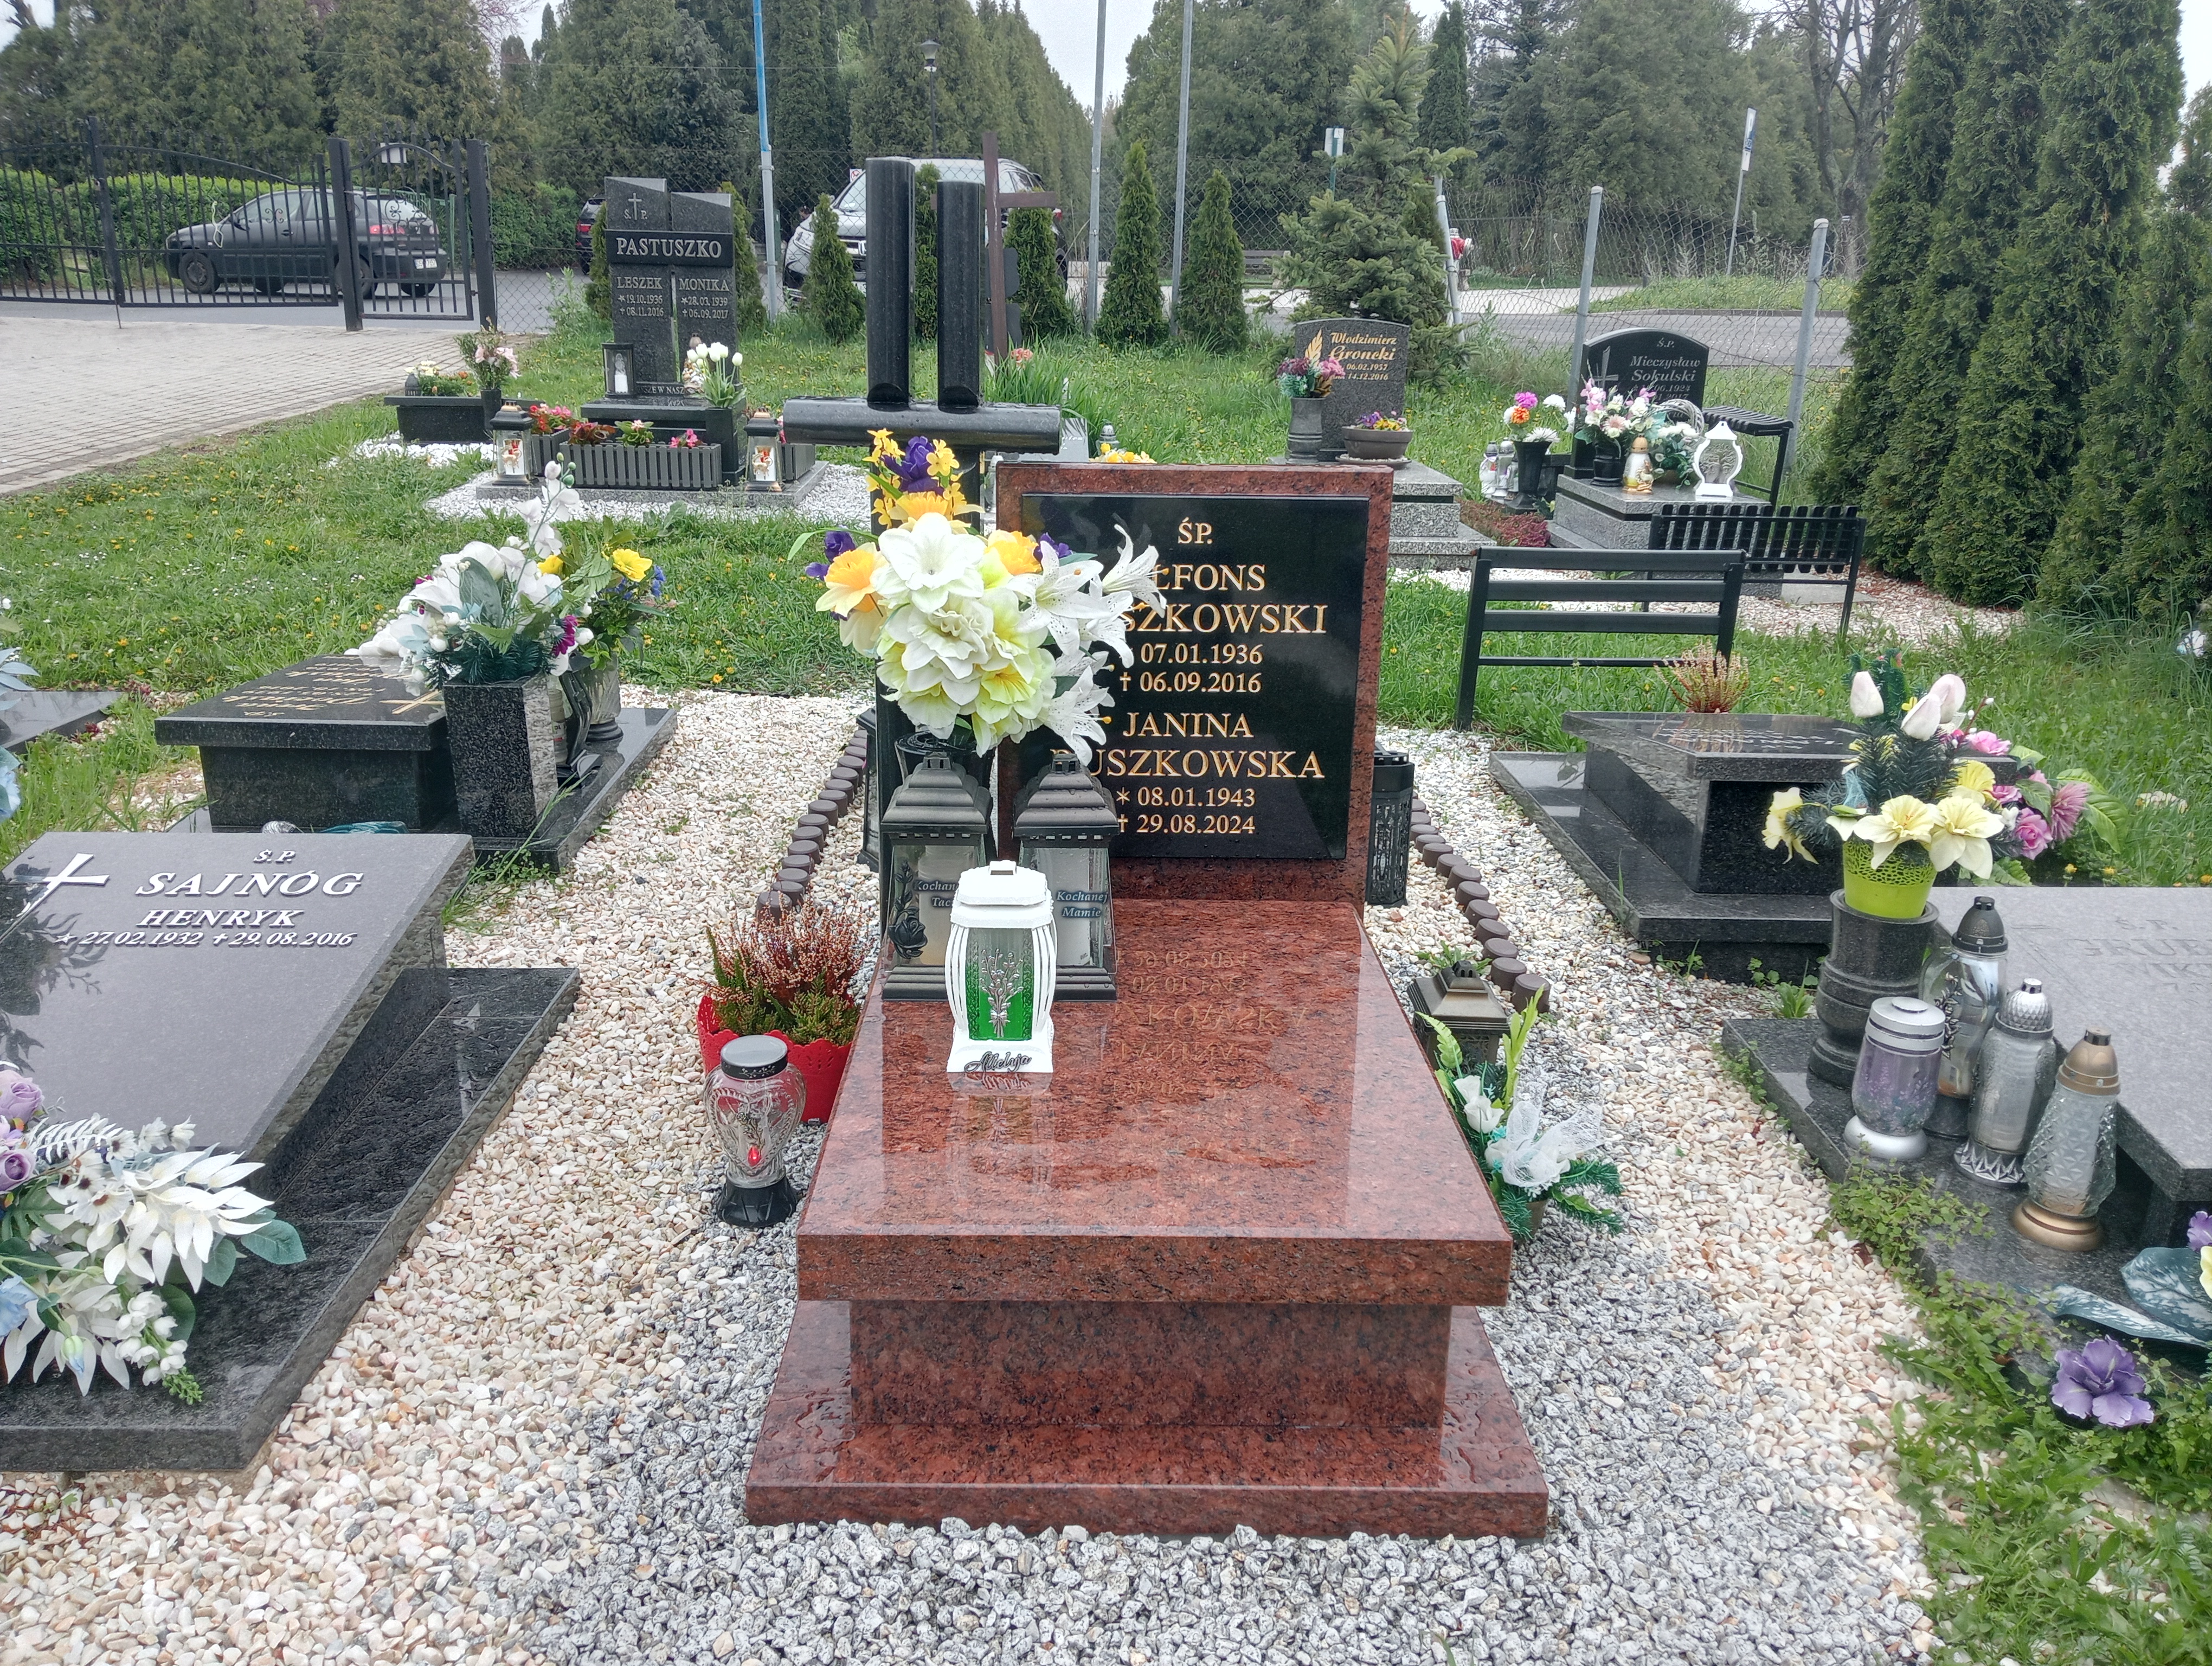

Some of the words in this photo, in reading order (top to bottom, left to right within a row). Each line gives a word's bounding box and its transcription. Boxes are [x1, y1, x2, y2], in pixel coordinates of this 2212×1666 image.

[640, 210, 648, 220] P.
[616, 237, 722, 258] PASTUSZKO
[617, 277, 663, 289] LESZEK
[679, 278, 730, 291] MONIKA
[626, 294, 663, 304] 19.10.1936
[687, 296, 728, 306] 28.03.1939
[626, 307, 664, 317] 08.11.2016
[688, 309, 729, 319] 06.09.2017
[1329, 331, 1398, 345] Włodzimierz
[1630, 355, 1701, 369] Mieczysław
[1631, 369, 1697, 382] Sokulski
[1178, 516, 1213, 544] ŚP.
[1152, 563, 1266, 591] LFONS
[1119, 604, 1328, 634] SZKOWSKI
[1140, 643, 1263, 665] 07.01.1936
[1140, 672, 1262, 693] 06.09.2016
[1123, 713, 1254, 738] JANINA
[1137, 787, 1256, 808] 08.01.1943
[1136, 814, 1256, 834] 29.08.2024
[135, 870, 364, 898] SAJNÓG
[914, 880, 959, 891] Kochan
[931, 897, 951, 907] Tac
[1056, 890, 1109, 904] Kochanej
[136, 909, 305, 928] HENRYK
[1062, 907, 1102, 917] Mamie
[78, 931, 204, 946] 27.02.1932
[228, 932, 358, 947] 29.08.2016
[964, 1051, 1032, 1073] Alleluja
